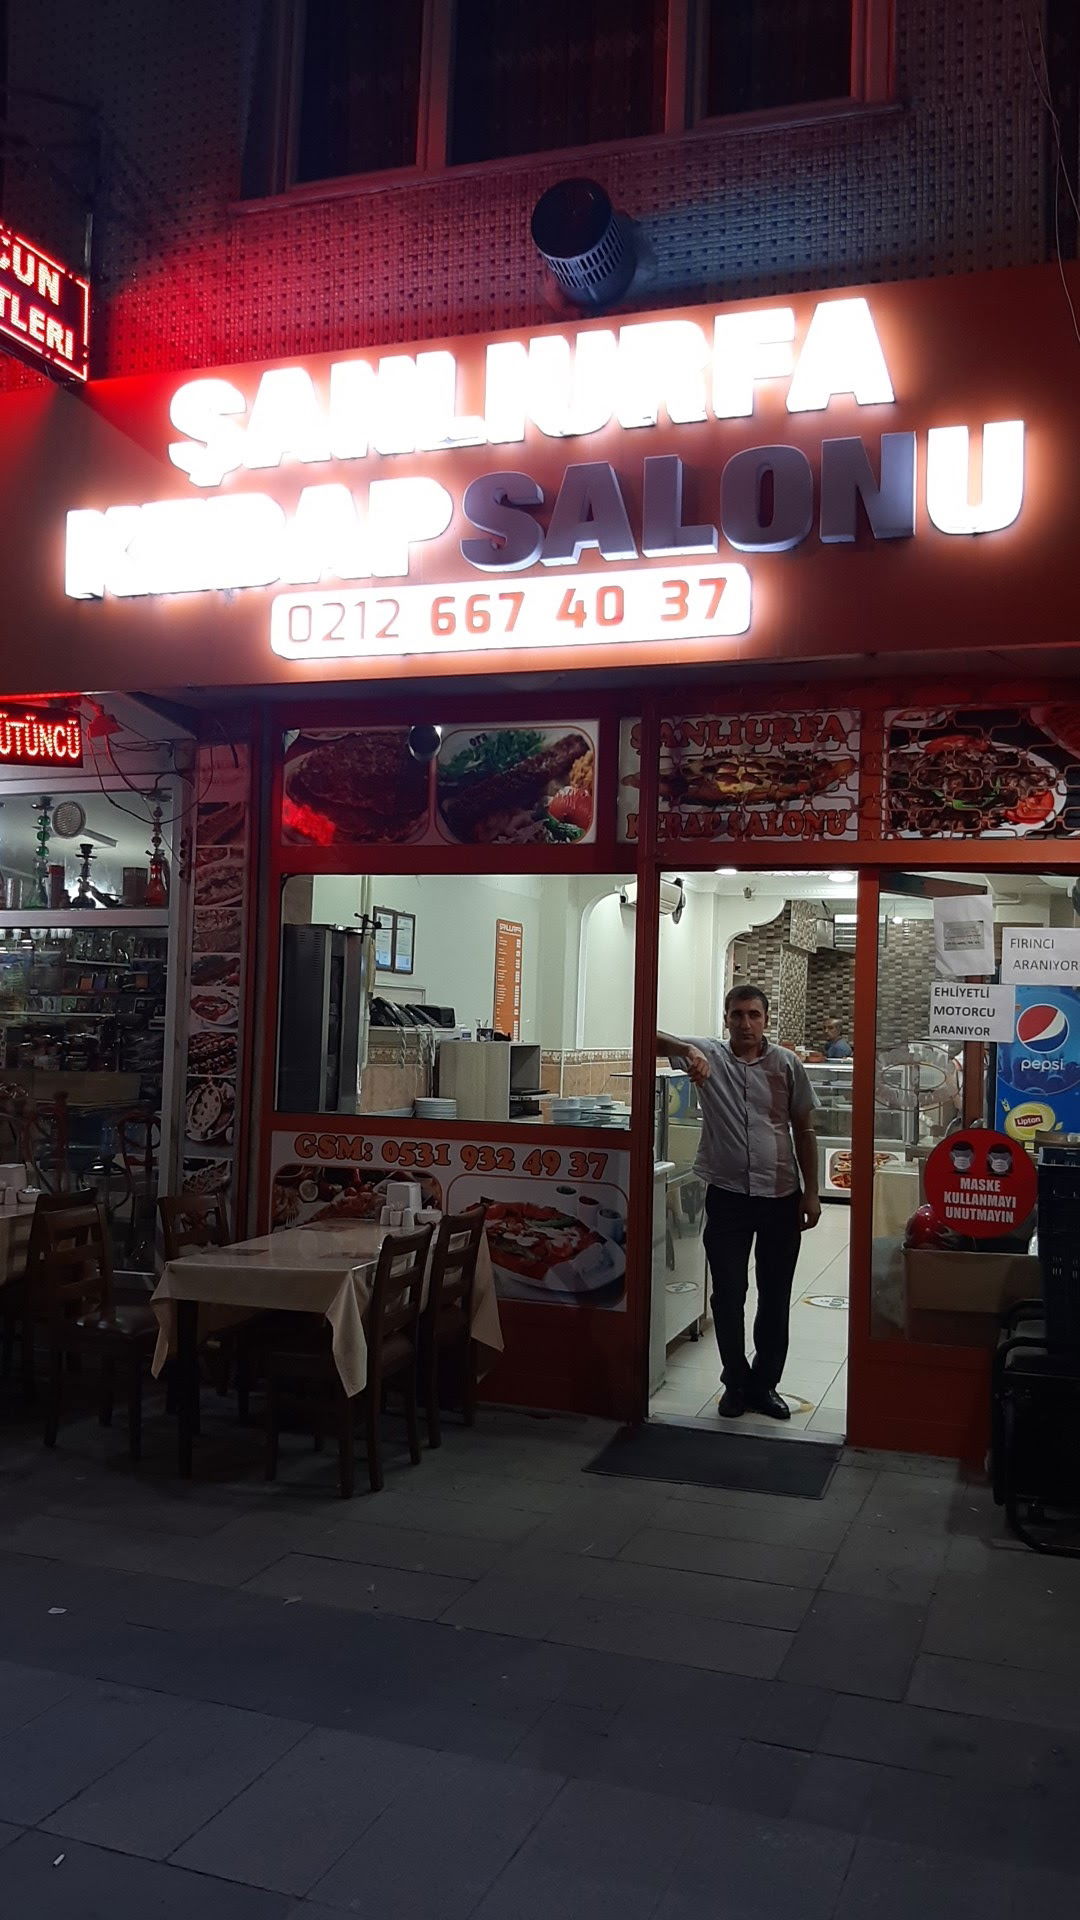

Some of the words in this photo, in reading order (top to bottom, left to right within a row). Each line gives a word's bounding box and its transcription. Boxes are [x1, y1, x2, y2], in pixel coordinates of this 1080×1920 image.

[460, 419, 1025, 573] SALONU
[288, 598, 400, 643] 0212
[430, 592, 525, 636] 667
[556, 584, 624, 628] 40
[660, 577, 728, 622] 37
[727, 808, 850, 837] SALONU
[1010, 938, 1055, 950] FIRINCI
[1012, 959, 1079, 972] ARANIYOR
[934, 985, 990, 999] EHLİYETLİ
[933, 1005, 996, 1018] MOTORCU
[932, 1025, 991, 1036] ARANIYOR
[1021, 1058, 1064, 1072] pepsi
[1016, 1115, 1041, 1127] Lipton
[294, 1133, 373, 1161] GSM:
[381, 1140, 451, 1168] 0531
[460, 1145, 515, 1171] 932
[522, 1149, 562, 1176] 49
[568, 1152, 609, 1180] 37
[960, 1177, 1001, 1193] MASKE
[943, 1191, 1017, 1209] KULLANMAYI
[945, 1206, 1014, 1224] UNUTMAYIN
